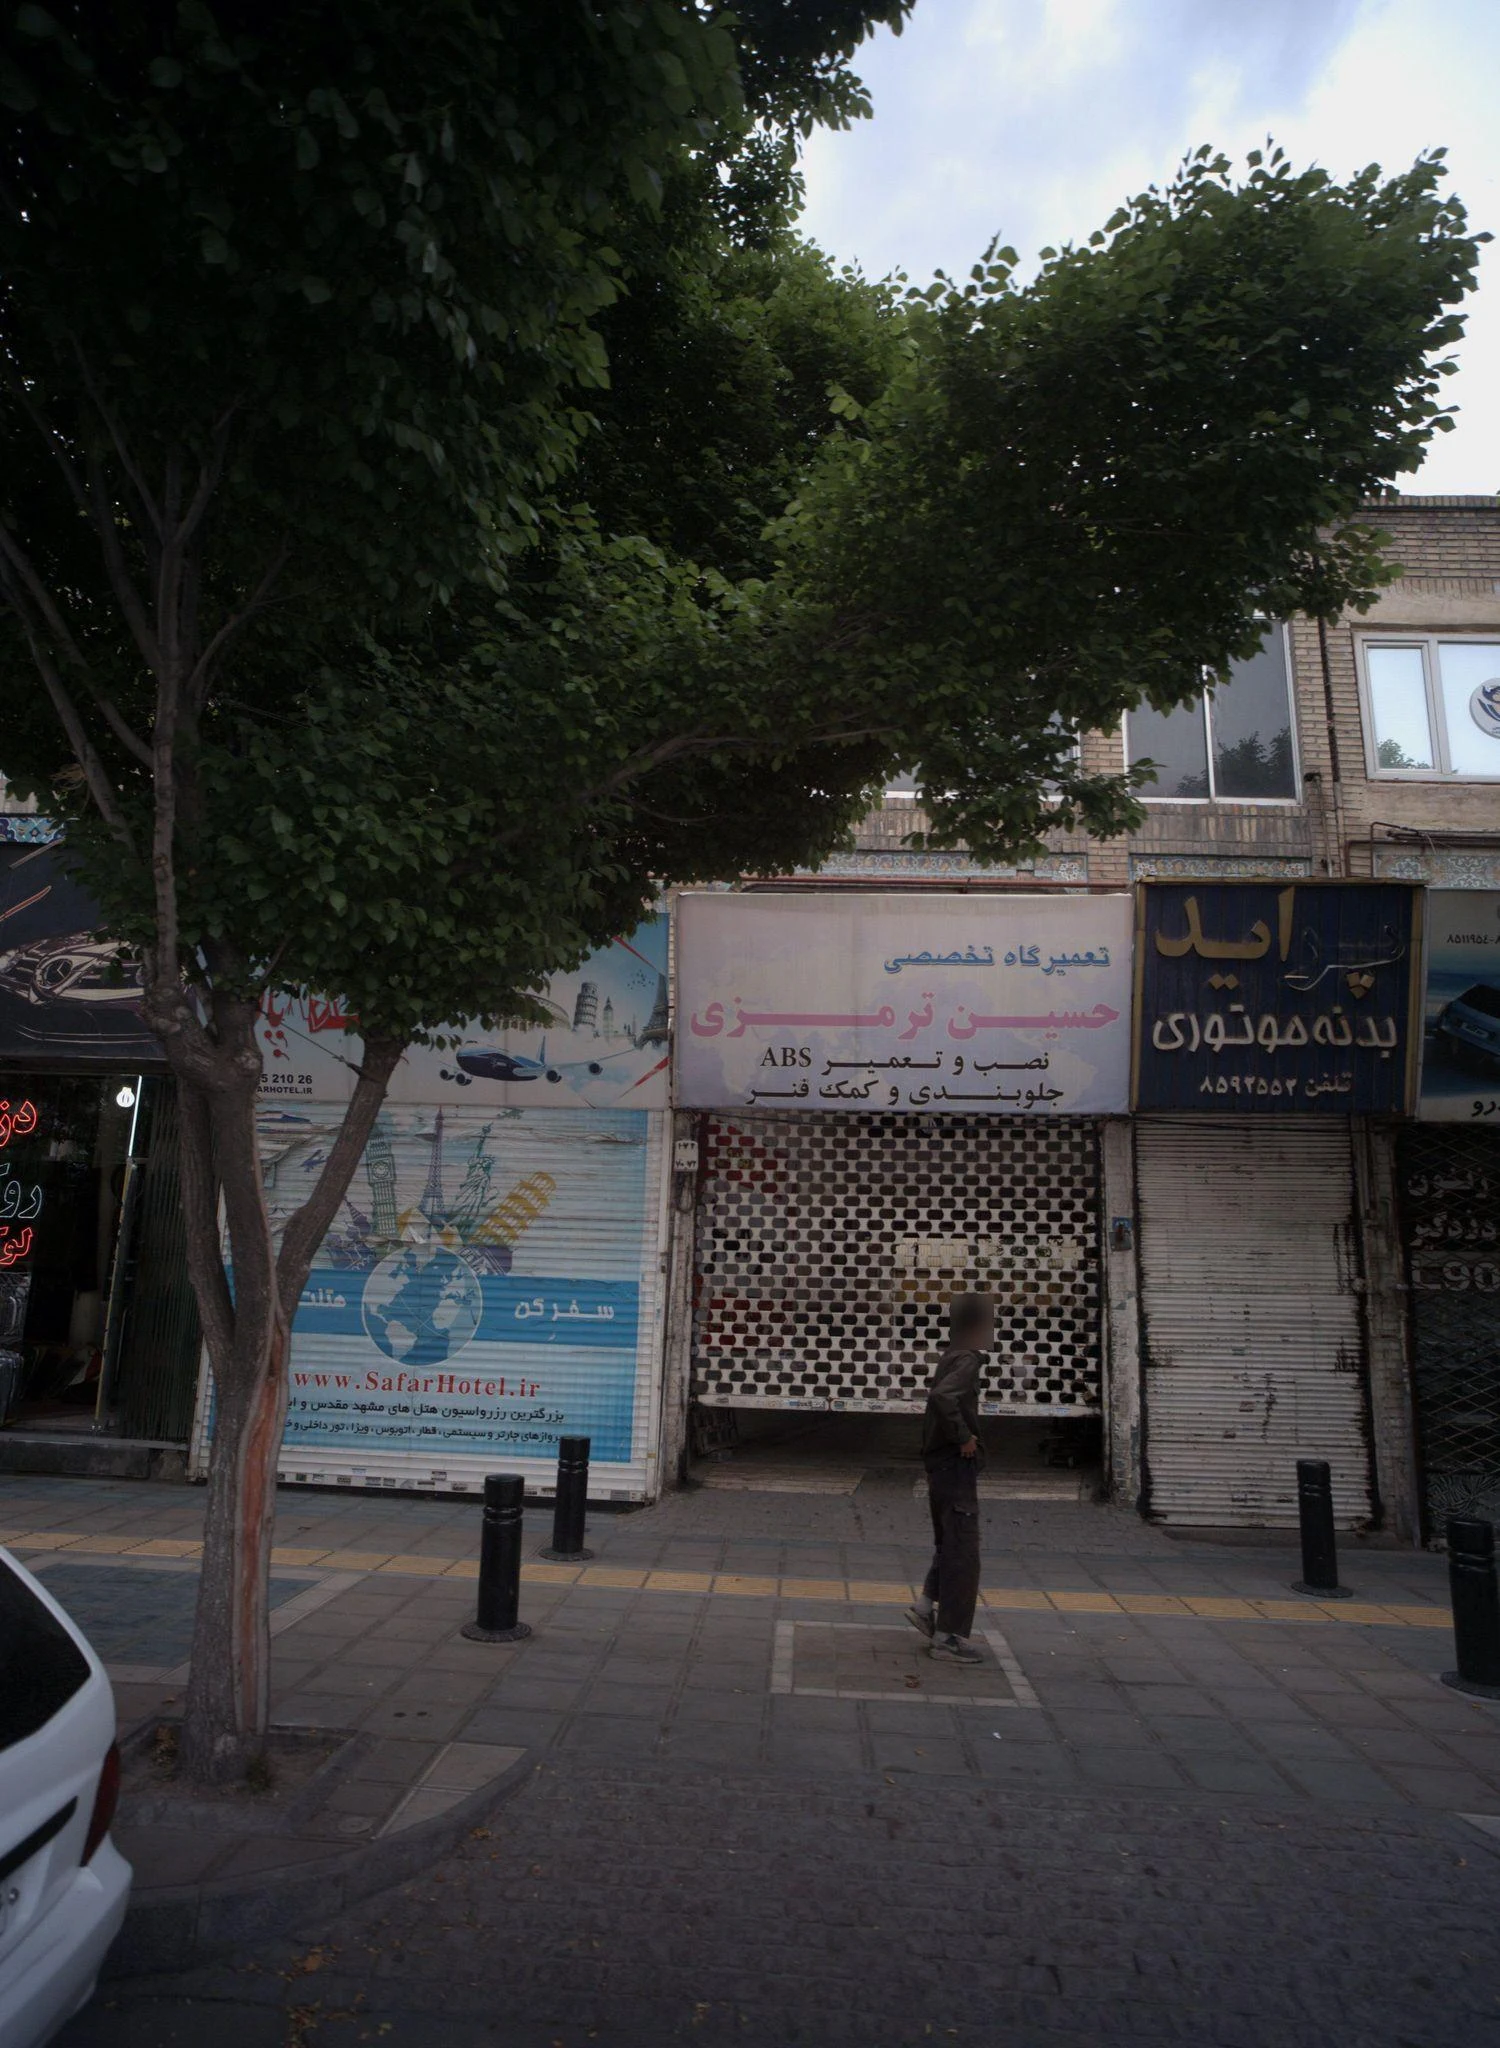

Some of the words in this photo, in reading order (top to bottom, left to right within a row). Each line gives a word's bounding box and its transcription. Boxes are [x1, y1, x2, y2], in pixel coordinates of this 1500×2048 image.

[884, 945, 994, 974] تخصصی
[1004, 945, 1111, 977] تعمیرگاه
[690, 992, 936, 1040] ترمزی
[947, 1000, 1120, 1040] حسین
[1152, 1003, 1309, 1054] موتوری
[1312, 1005, 1398, 1058] بدنه
[760, 1046, 813, 1068] ABS
[820, 1052, 942, 1075] تعمیر
[953, 1057, 964, 1075] و
[973, 1053, 1049, 1072] نصب
[257, 1085, 313, 1095] ARHOTEL.IR
[272, 1073, 294, 1084] 210
[298, 1074, 313, 1085] 26
[819, 1078, 880, 1099] کمک
[1304, 1071, 1353, 1098] تلفن
[744, 1078, 810, 1105] فنر
[888, 1086, 899, 1105] و
[908, 1081, 1065, 1109] جلوبندی
[1410, 1260, 1500, 1292] L90
[550, 1298, 615, 1322] سفر
[293, 1370, 541, 1398] www.SafarHotel.ir
[310, 1399, 348, 1411] مقدس
[351, 1401, 385, 1414] مشهد
[387, 1403, 410, 1416] های
[412, 1403, 438, 1417] هتل
[441, 1406, 506, 1420] رزرواسیون
[510, 1407, 565, 1422] بزرگترین
